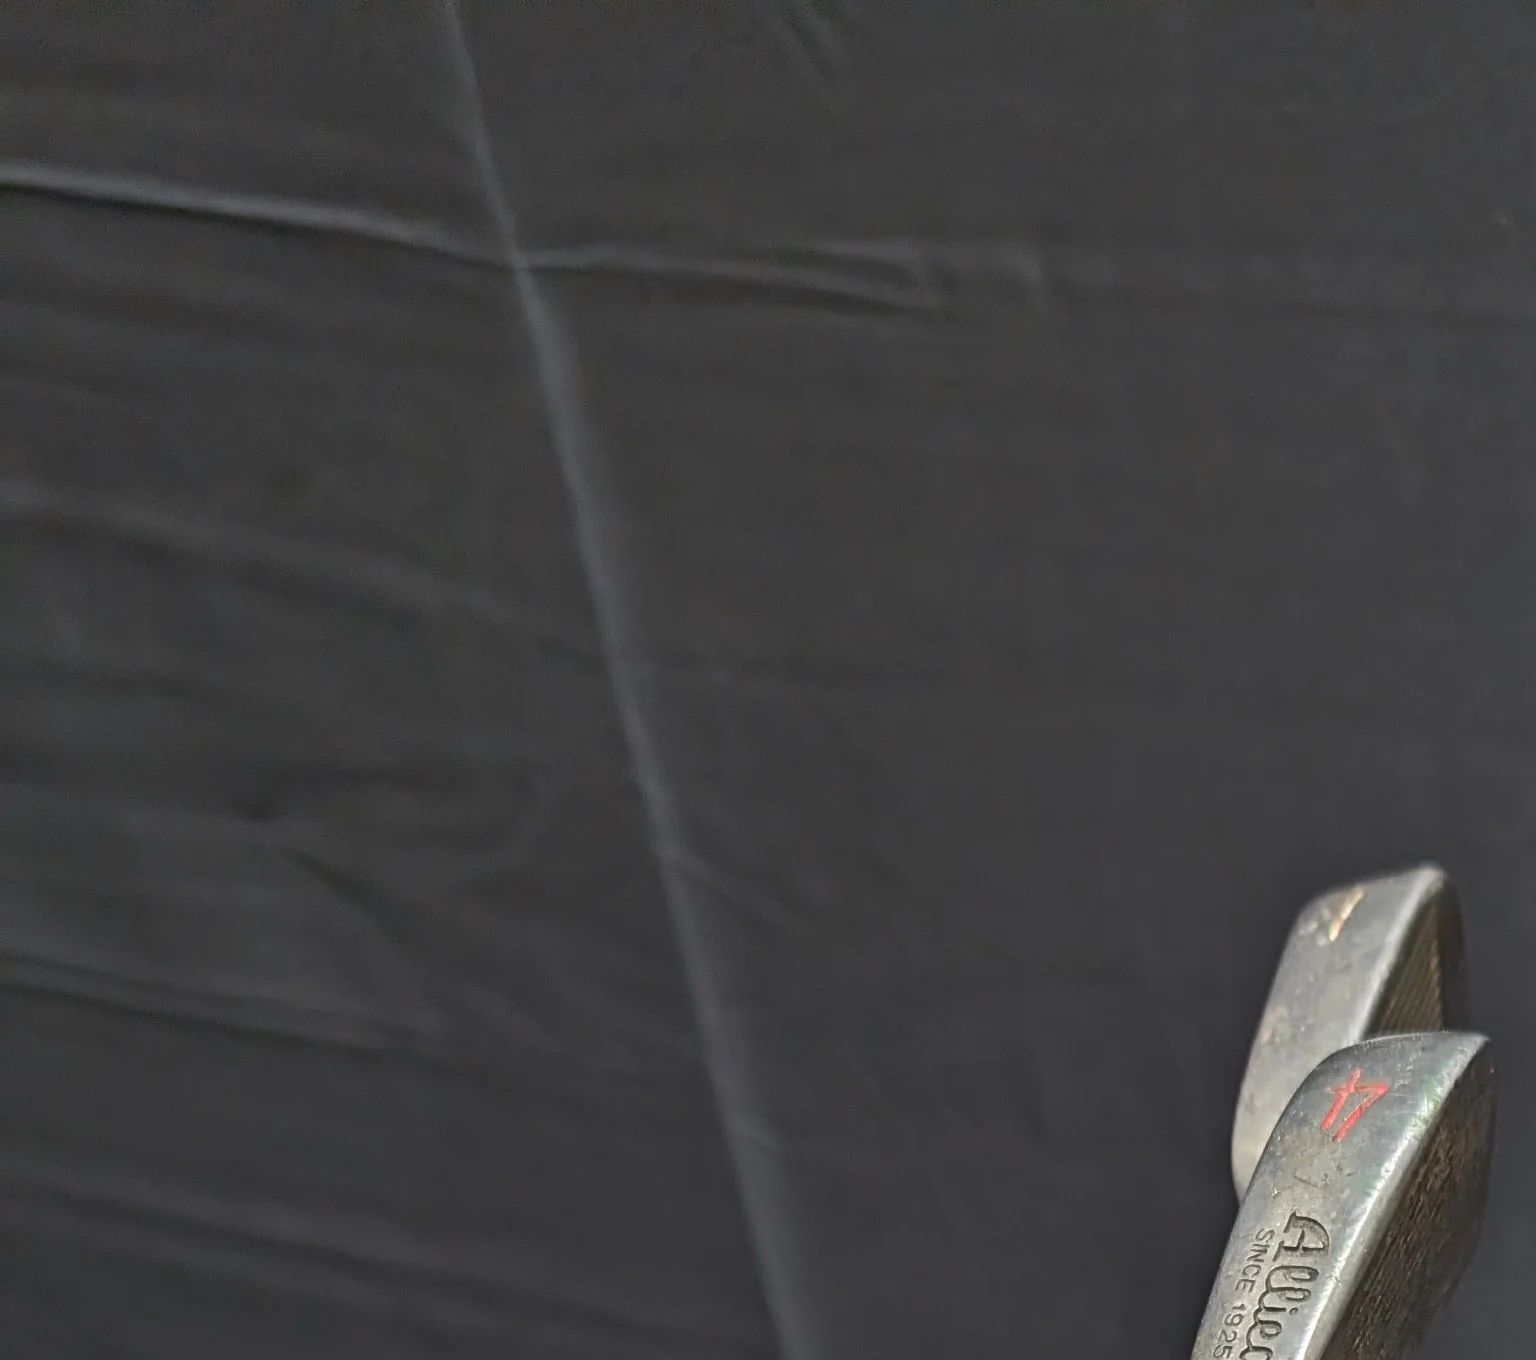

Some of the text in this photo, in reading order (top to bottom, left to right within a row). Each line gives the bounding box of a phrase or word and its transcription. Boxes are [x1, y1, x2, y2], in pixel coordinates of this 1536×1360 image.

[1321, 1068, 1389, 1143] 4
[1212, 1227, 1276, 1360] SINCE 1925
